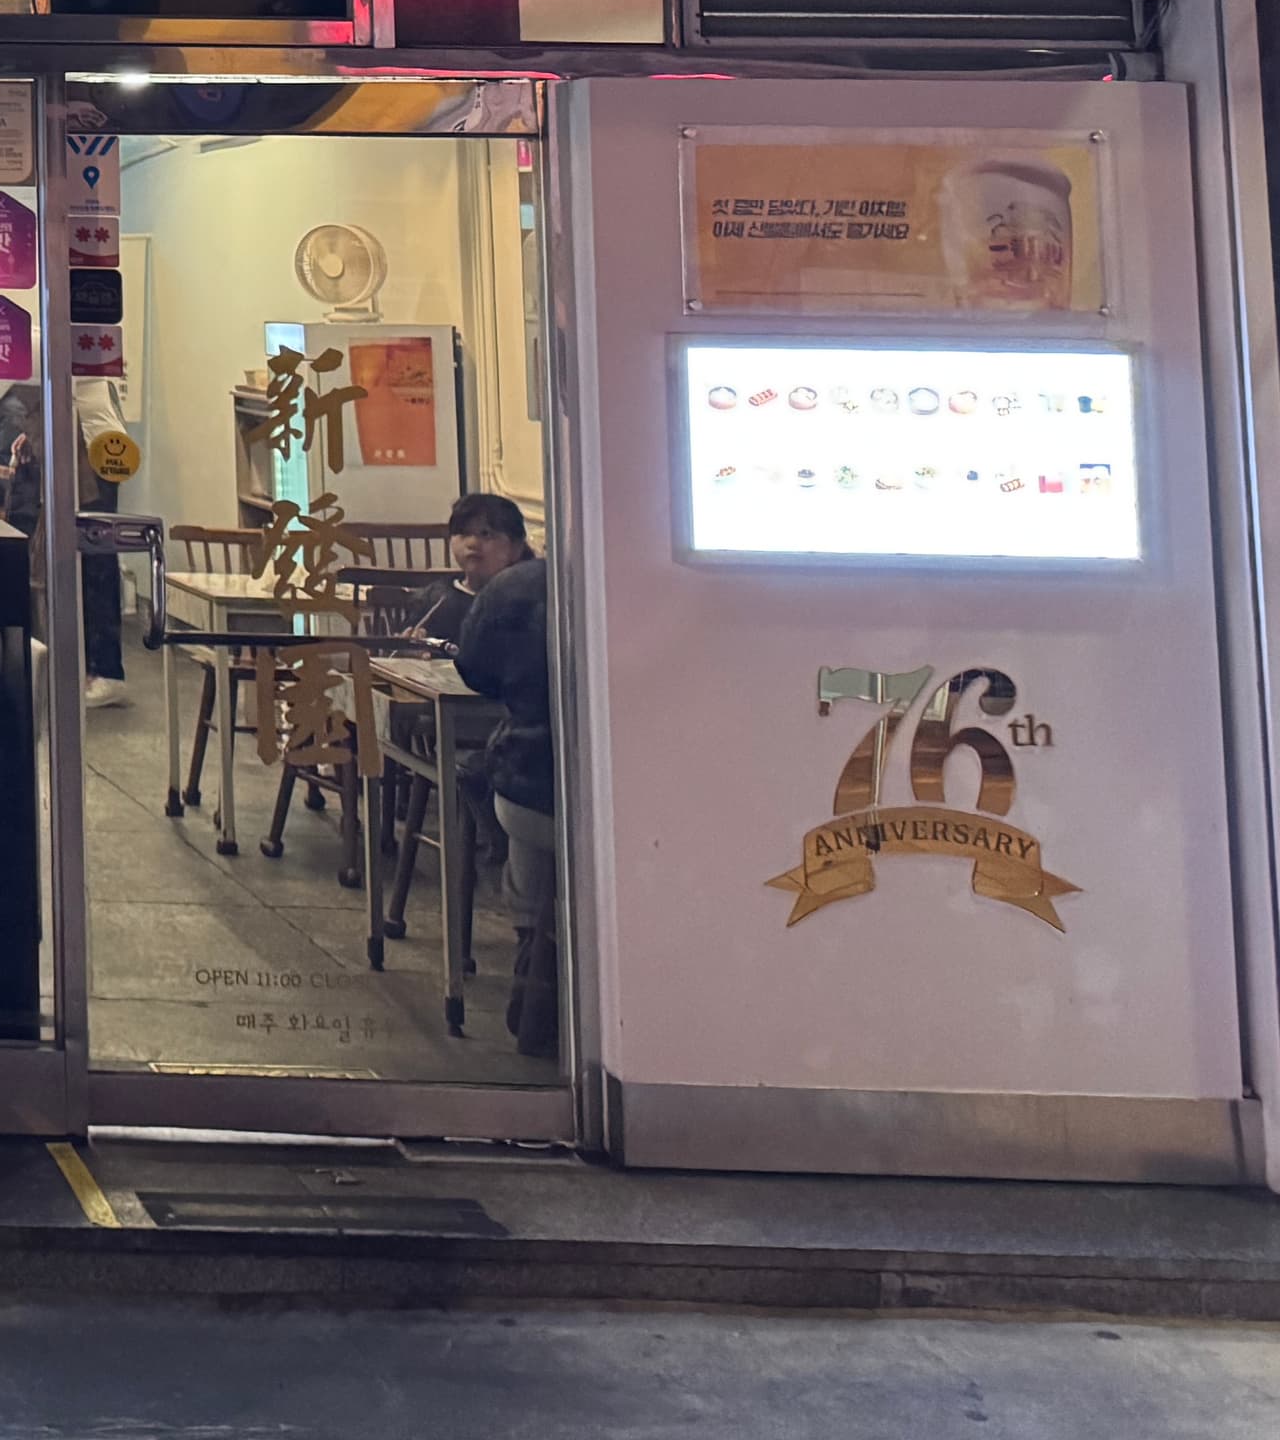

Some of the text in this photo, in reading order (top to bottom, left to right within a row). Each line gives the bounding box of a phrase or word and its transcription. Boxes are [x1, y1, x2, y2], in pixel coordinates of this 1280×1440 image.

[195, 969, 249, 987] OPEN
[256, 971, 302, 989] 11:00
[235, 1013, 280, 1035] 매주
[287, 1014, 351, 1044] 화요일
